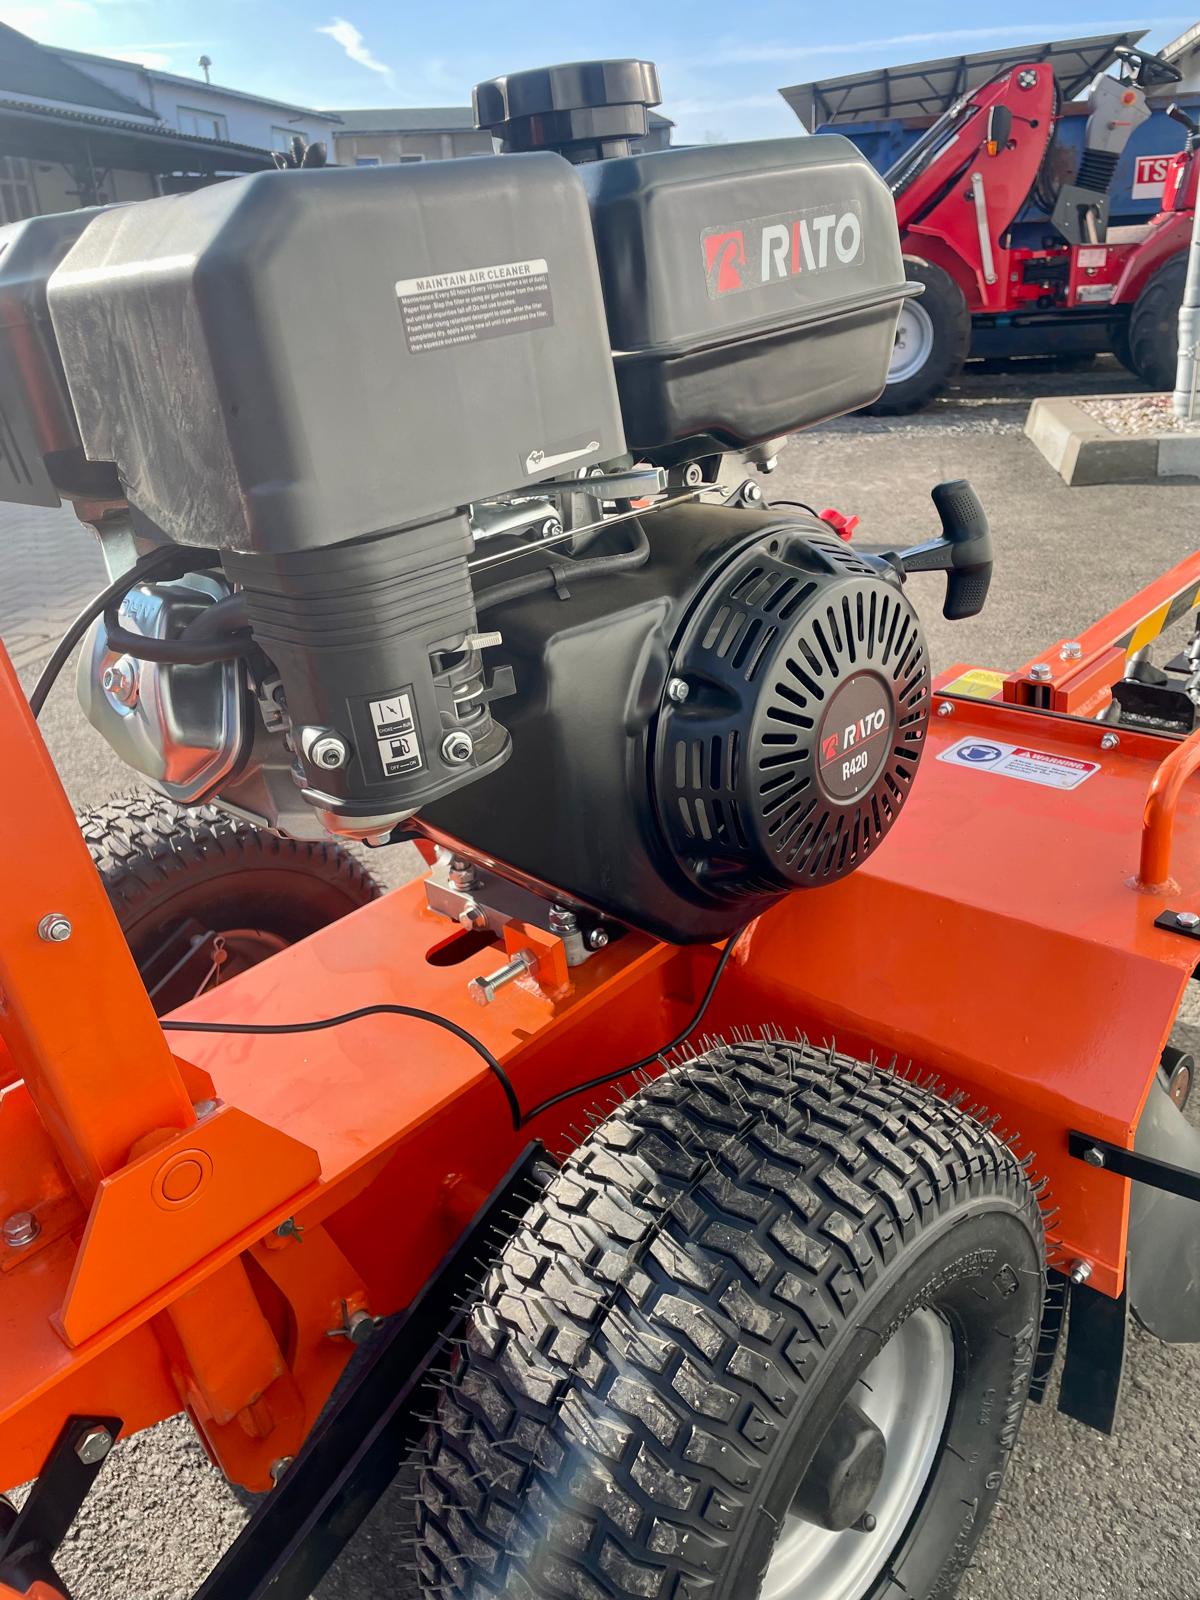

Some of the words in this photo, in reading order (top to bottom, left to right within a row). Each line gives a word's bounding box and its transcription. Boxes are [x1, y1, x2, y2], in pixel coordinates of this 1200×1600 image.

[762, 212, 860, 282] RATO
[416, 274, 467, 291] MAINTAIN
[469, 271, 486, 283] AIR
[487, 264, 531, 280] CLEANER
[403, 306, 419, 314] Paper
[843, 708, 886, 750] RATO
[842, 751, 868, 781] R420
[1031, 753, 1085, 770] WARNING
